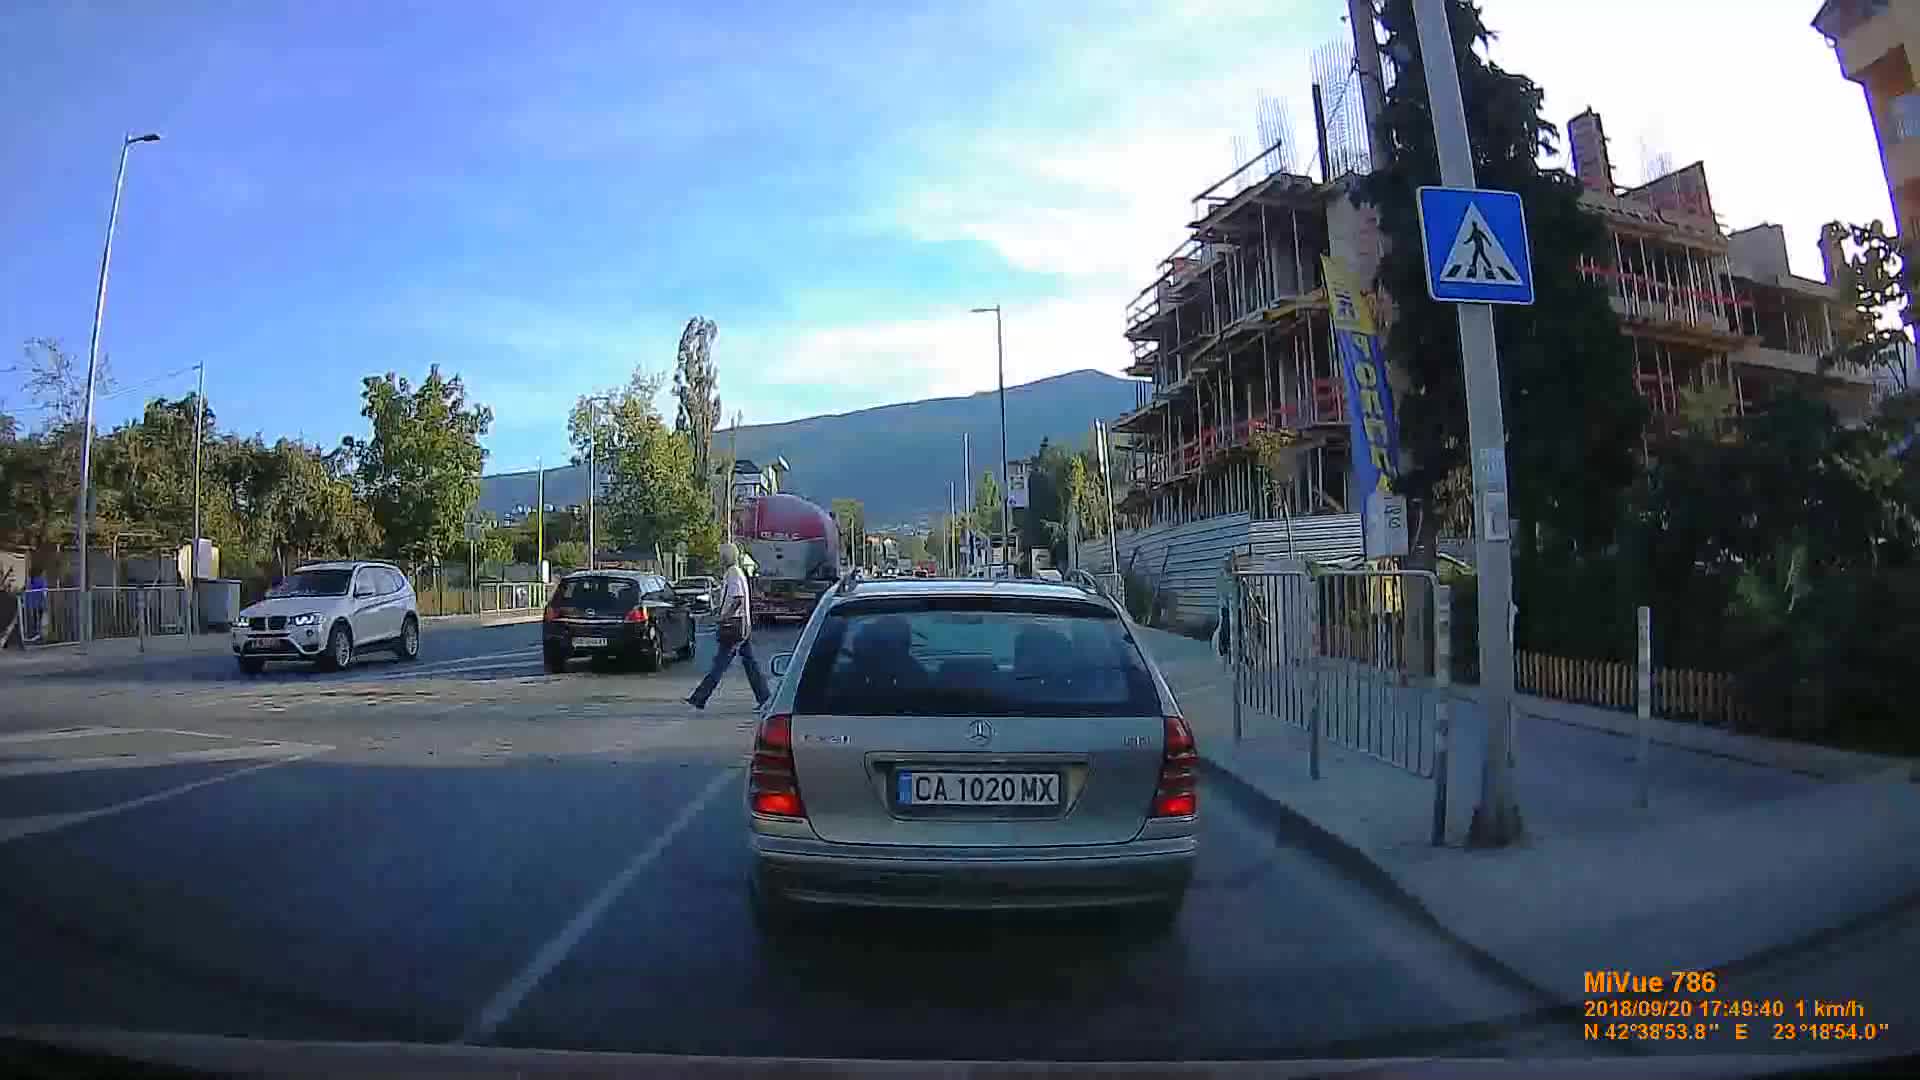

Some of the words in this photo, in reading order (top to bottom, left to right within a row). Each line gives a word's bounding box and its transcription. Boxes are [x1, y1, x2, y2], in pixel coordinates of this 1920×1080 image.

[915, 775, 948, 801] CA
[956, 775, 1016, 801] 1020
[1020, 775, 1056, 801] MX
